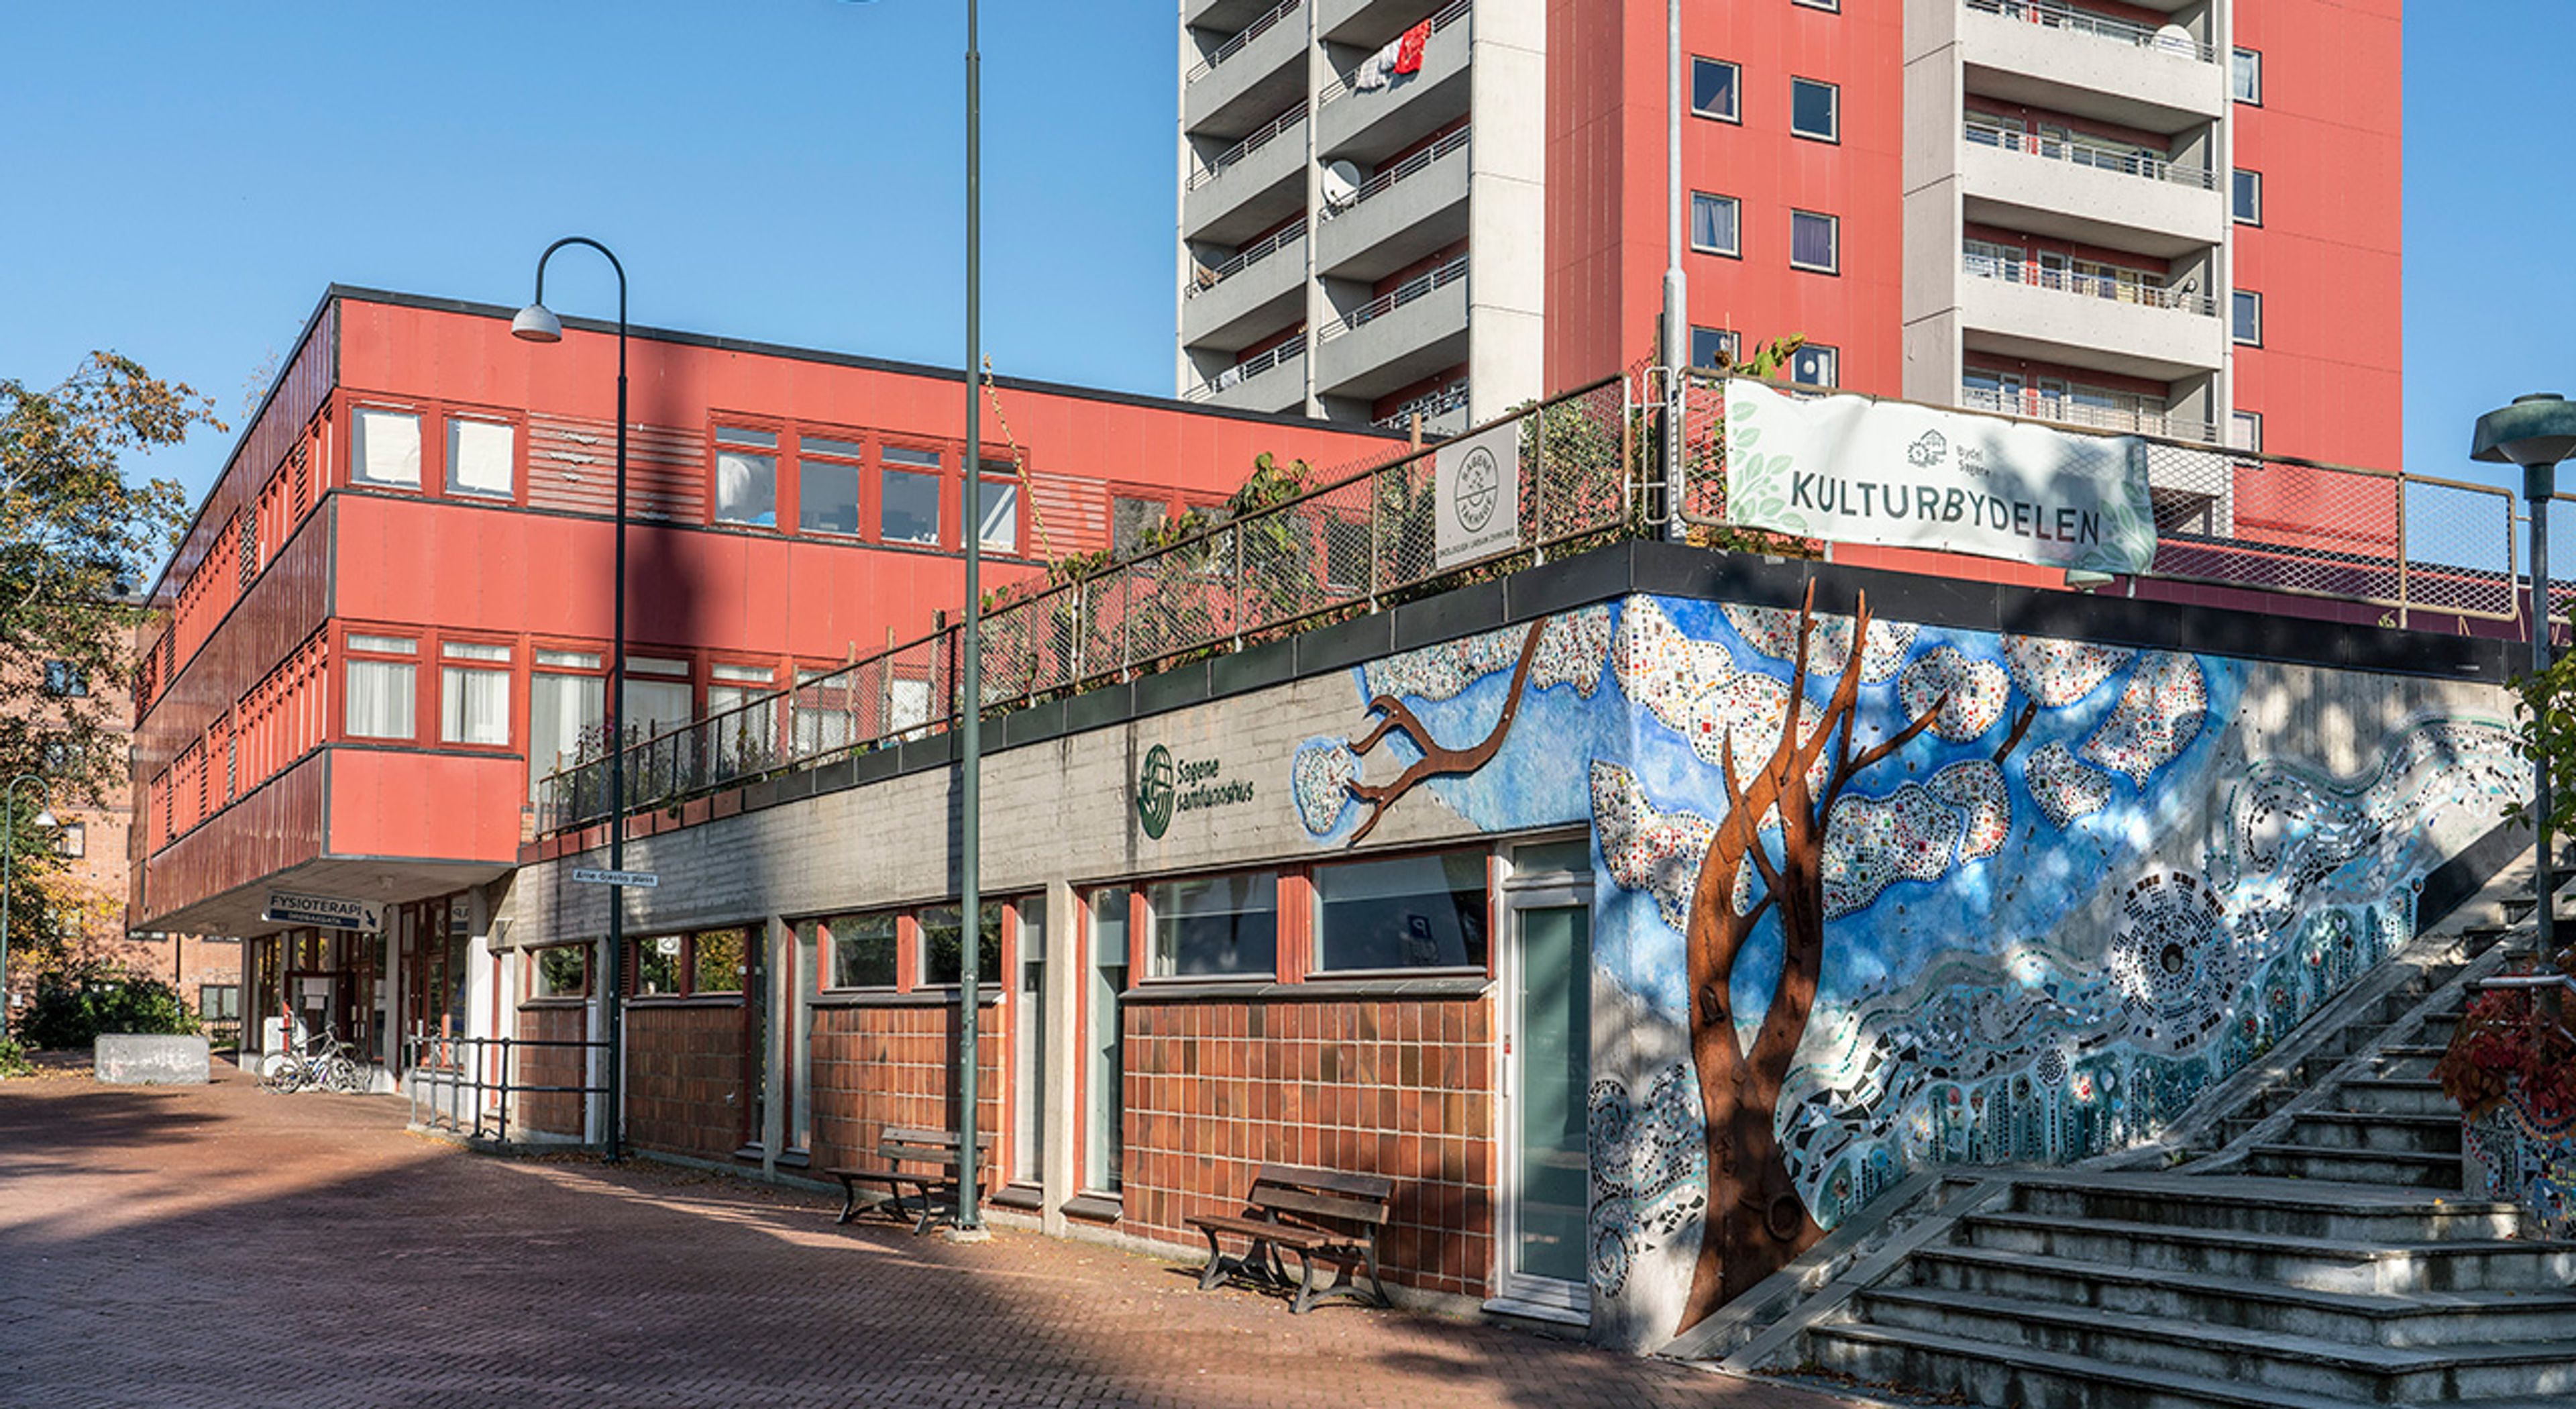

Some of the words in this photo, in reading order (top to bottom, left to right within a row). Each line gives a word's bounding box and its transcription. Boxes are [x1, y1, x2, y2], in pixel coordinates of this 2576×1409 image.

[1956, 445, 1983, 461] Bydel
[1958, 459, 1990, 478] Sagene
[1790, 470, 2100, 546] KULTURBYDELEN
[1177, 758, 1219, 788] Sagene
[1177, 780, 1254, 813] samfunnshus
[576, 871, 596, 880] Arne
[270, 895, 362, 915] FYSIOTERAPI
